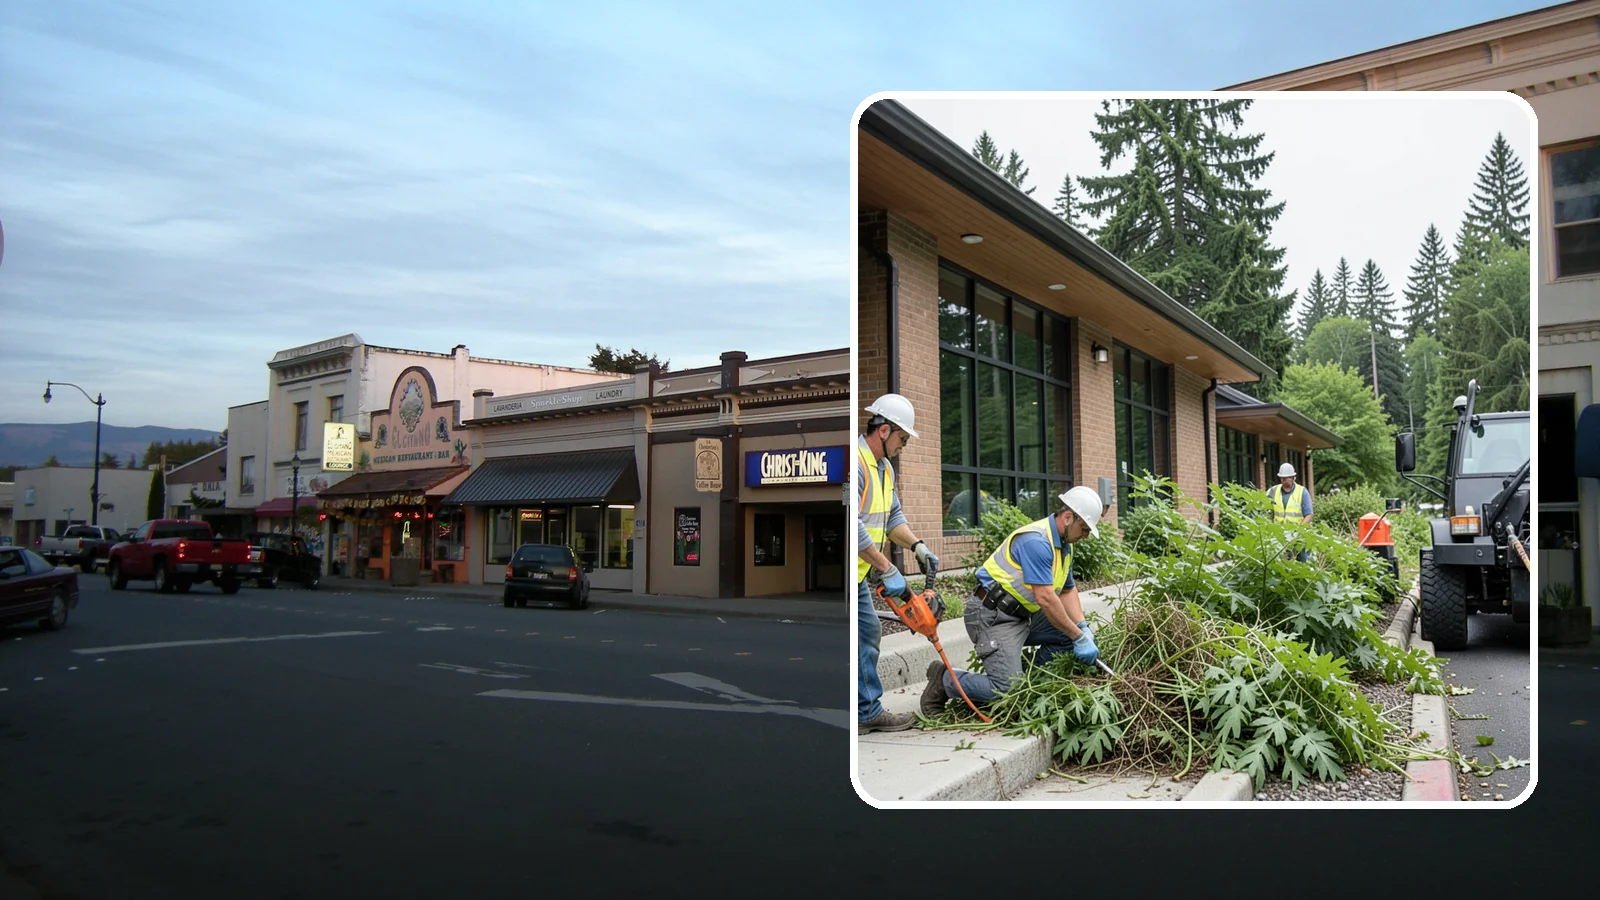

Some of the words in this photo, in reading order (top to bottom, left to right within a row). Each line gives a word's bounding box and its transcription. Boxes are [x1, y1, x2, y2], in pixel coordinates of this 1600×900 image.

[595, 389, 624, 400] LAUNDRY
[530, 397, 560, 408] Sparkle
[561, 394, 582, 405] Shop
[493, 402, 523, 413] LAVANDERIA
[327, 450, 352, 458] MEXICAN
[373, 454, 396, 464] MEXICAN
[397, 451, 433, 462] RESTAURANT
[437, 450, 450, 459] BAR
[761, 452, 797, 478] CHRIST
[799, 450, 827, 476] KING
